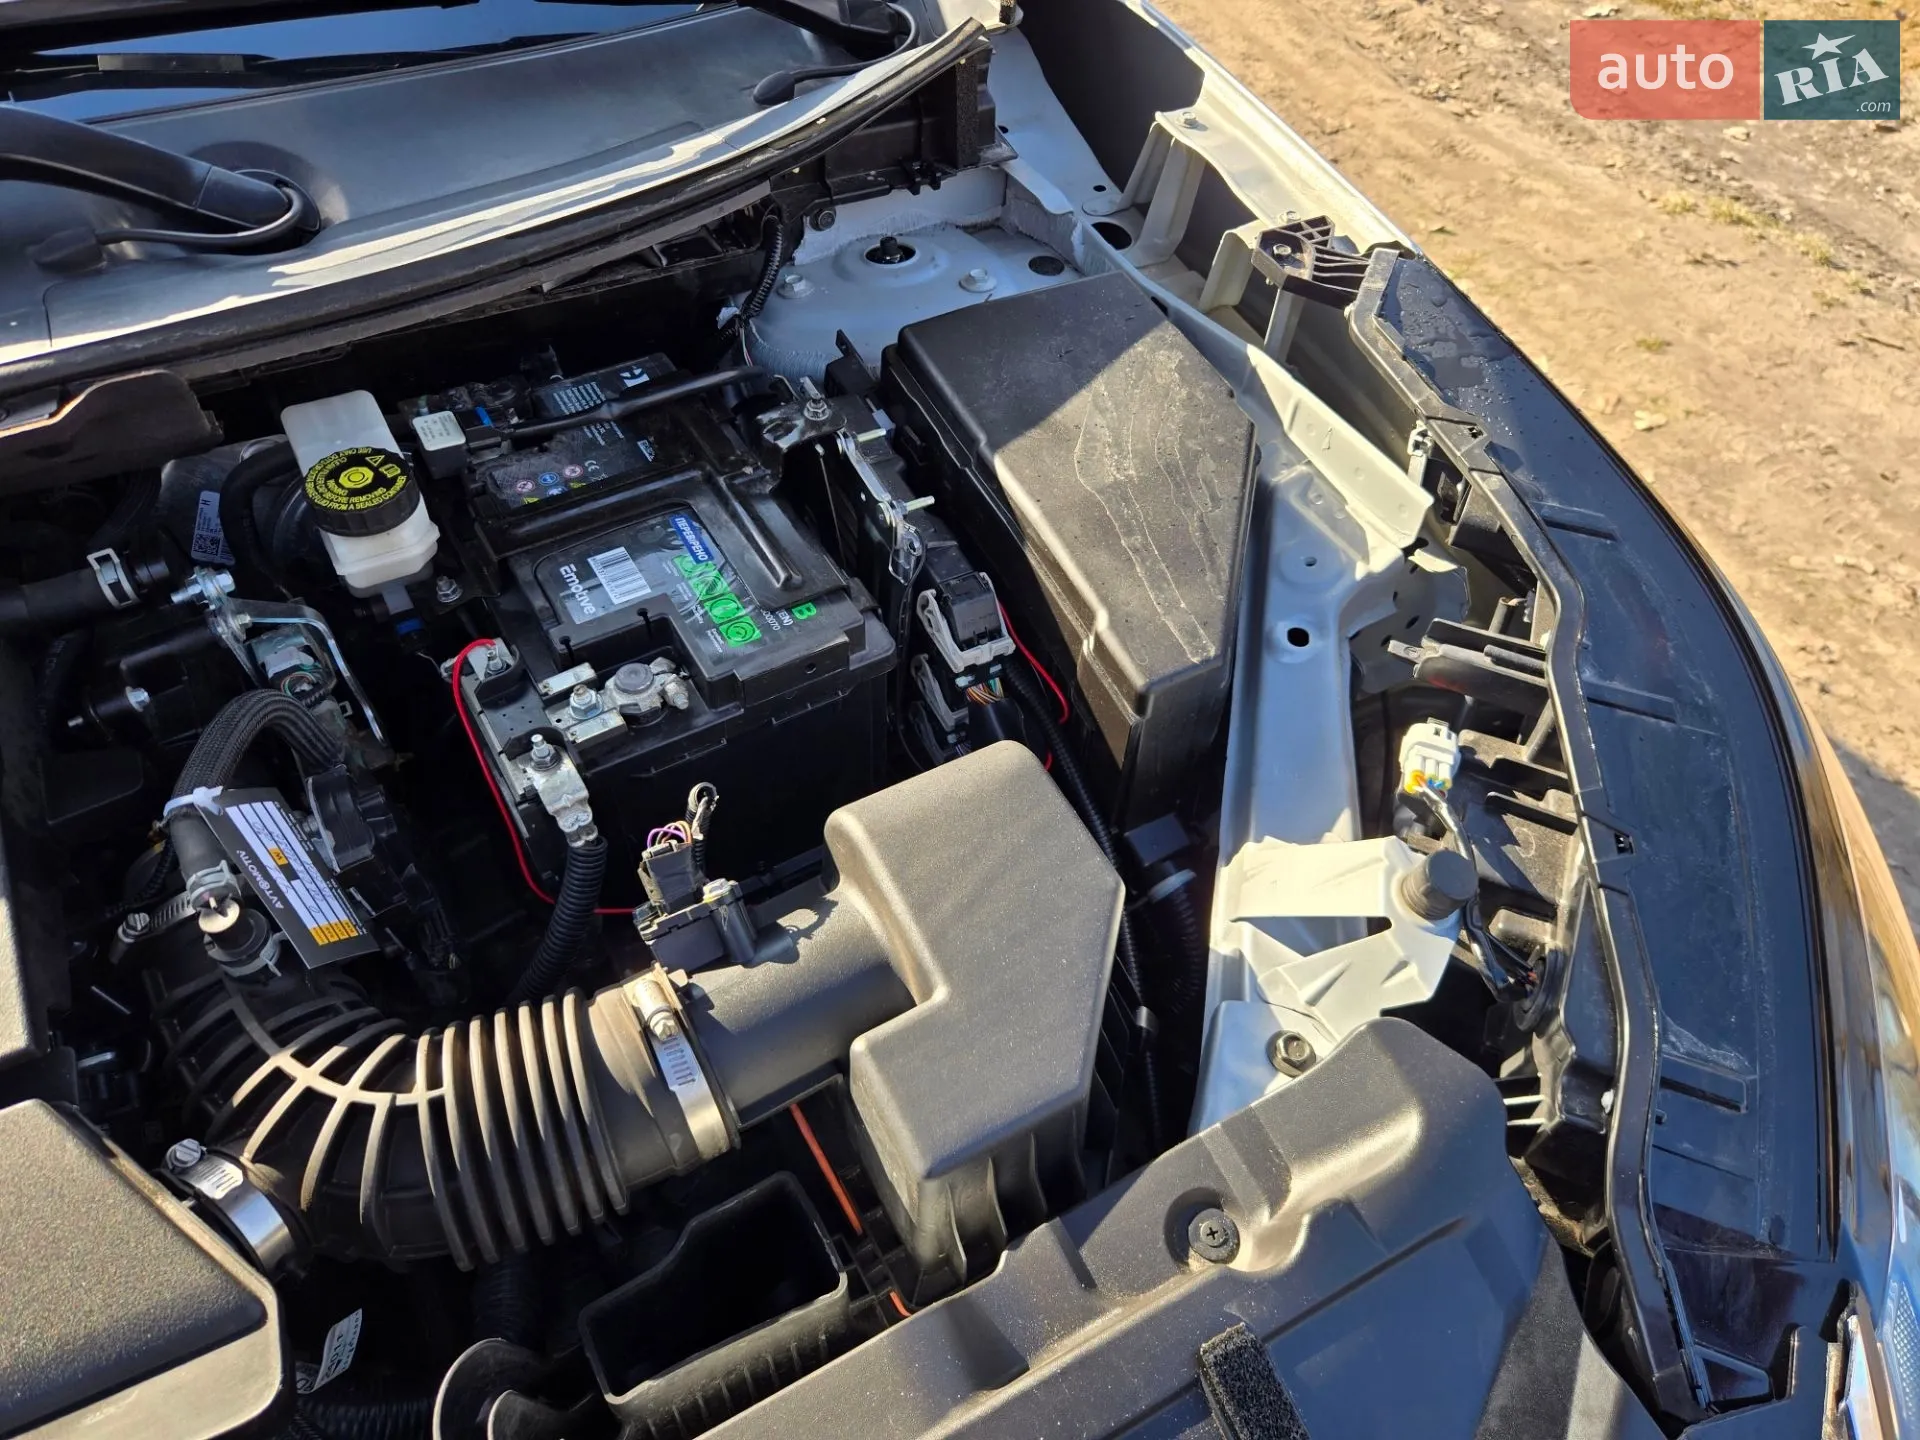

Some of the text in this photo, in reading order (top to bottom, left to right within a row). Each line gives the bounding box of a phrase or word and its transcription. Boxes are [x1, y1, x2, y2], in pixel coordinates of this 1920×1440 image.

[321, 490, 349, 504] BEFORE
[348, 486, 388, 503] REMOVING
[326, 501, 348, 511] FROM
[355, 496, 385, 509] SEALED
[380, 475, 406, 501] CONTAINER
[673, 515, 709, 562] ПЕРЕВІРЕНО
[559, 564, 596, 615] Emotive
[272, 851, 283, 860] W
